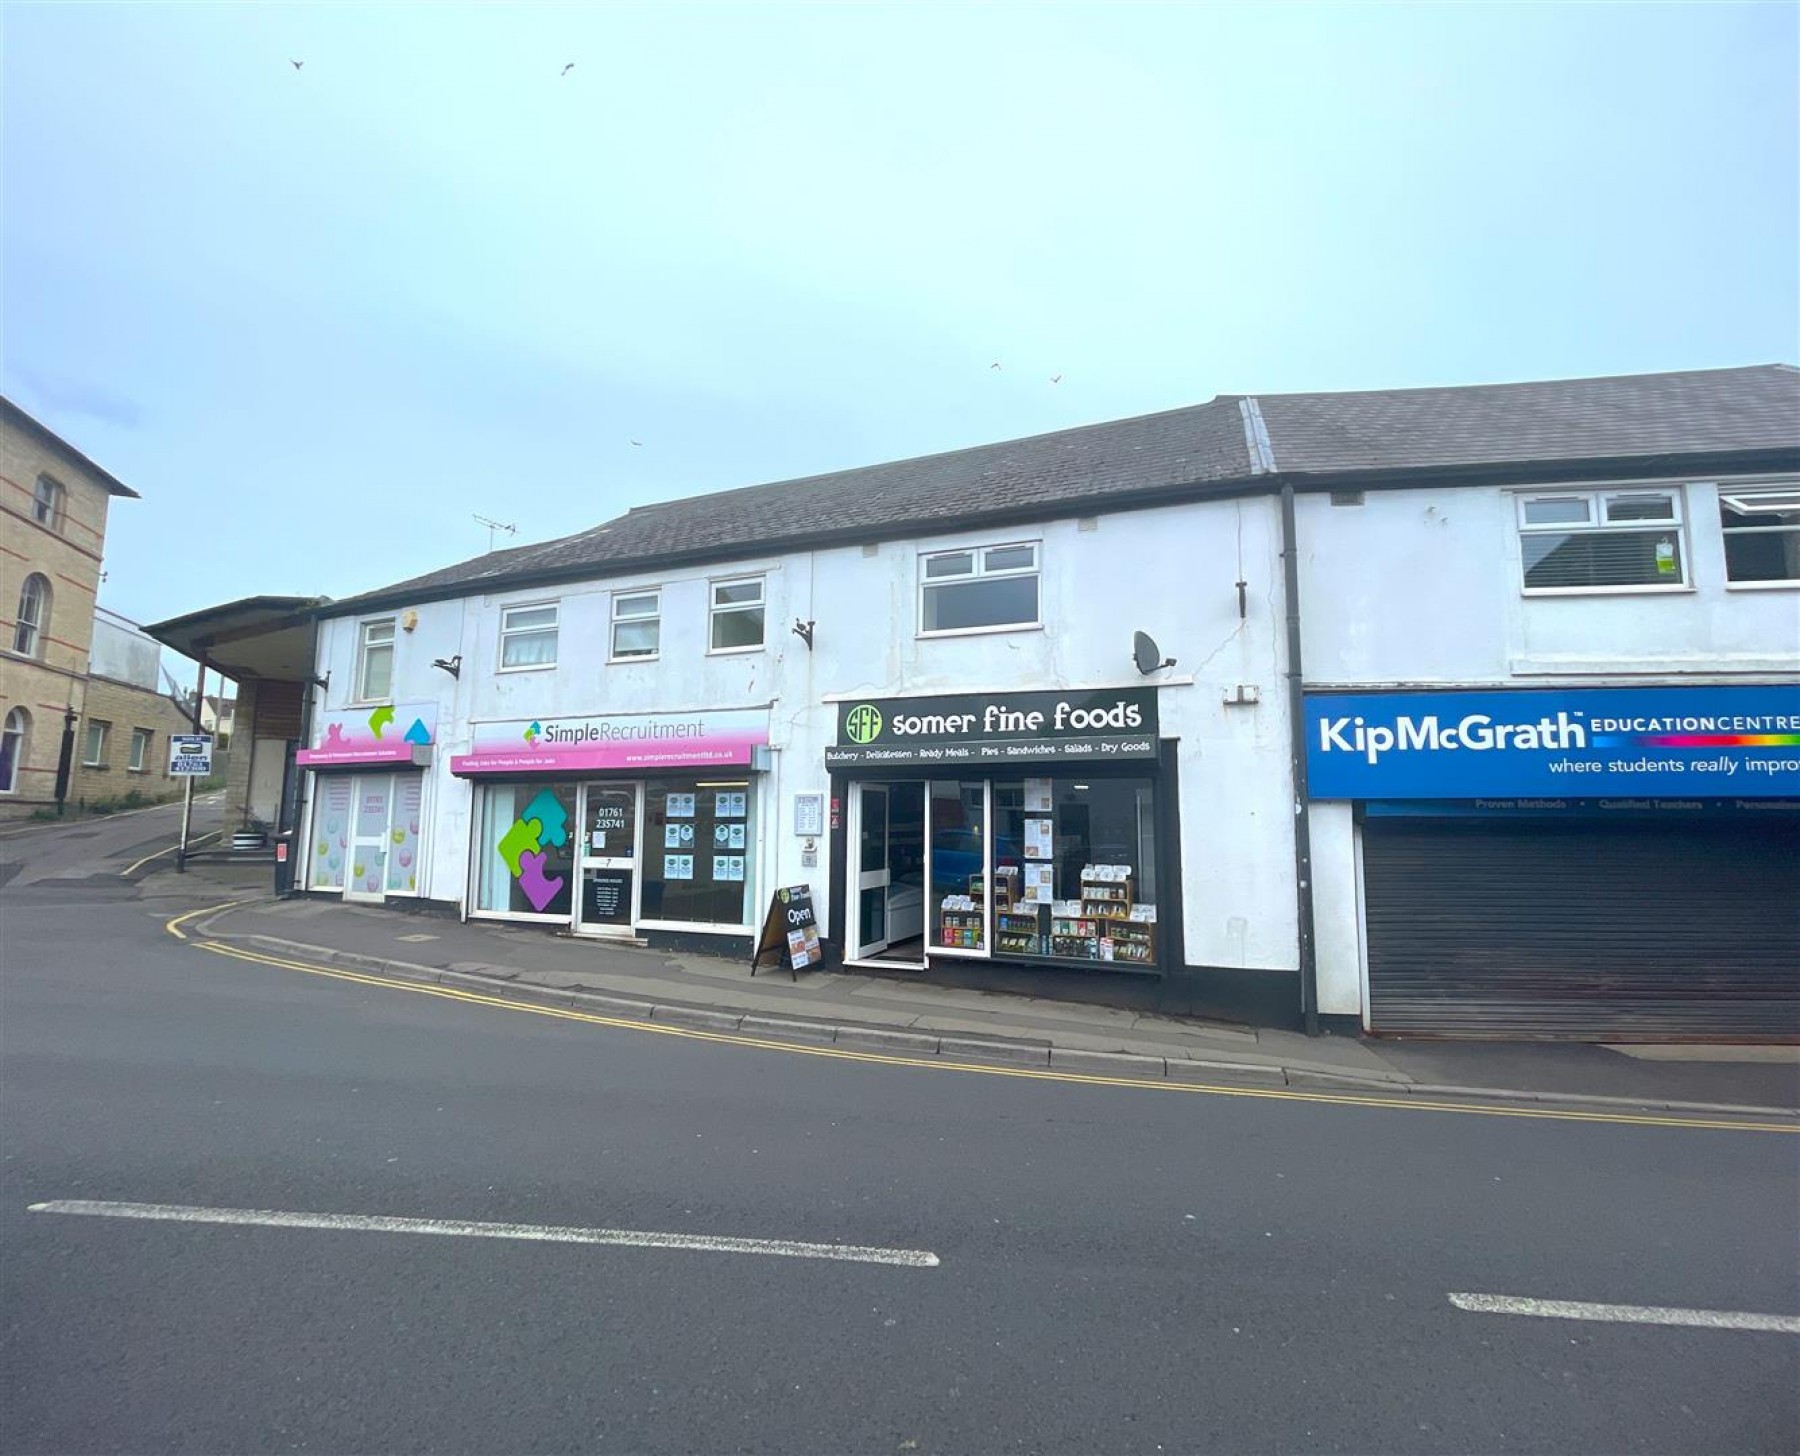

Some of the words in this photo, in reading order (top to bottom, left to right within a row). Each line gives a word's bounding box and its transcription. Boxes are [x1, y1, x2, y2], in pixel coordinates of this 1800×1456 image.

[849, 706, 880, 741] SFF
[892, 713, 976, 735] somer
[983, 704, 1044, 732] fine
[1054, 701, 1142, 730] foods
[827, 751, 859, 762] Butchery
[866, 749, 912, 760] Delicatessen
[919, 748, 942, 759] Ready
[945, 747, 969, 757] Meals
[981, 746, 999, 755] Pies
[1006, 744, 1056, 755] Sandwiches
[1064, 743, 1092, 753] Salads
[1101, 742, 1118, 754] Dry
[1121, 741, 1150, 752] Goods
[1549, 757, 1602, 773] where
[1608, 756, 1684, 772] students
[1690, 756, 1738, 775] really
[1745, 756, 1800, 776] impro
[598, 807, 623, 818] 01761
[596, 819, 625, 829] 235741
[788, 907, 811, 925] Open
